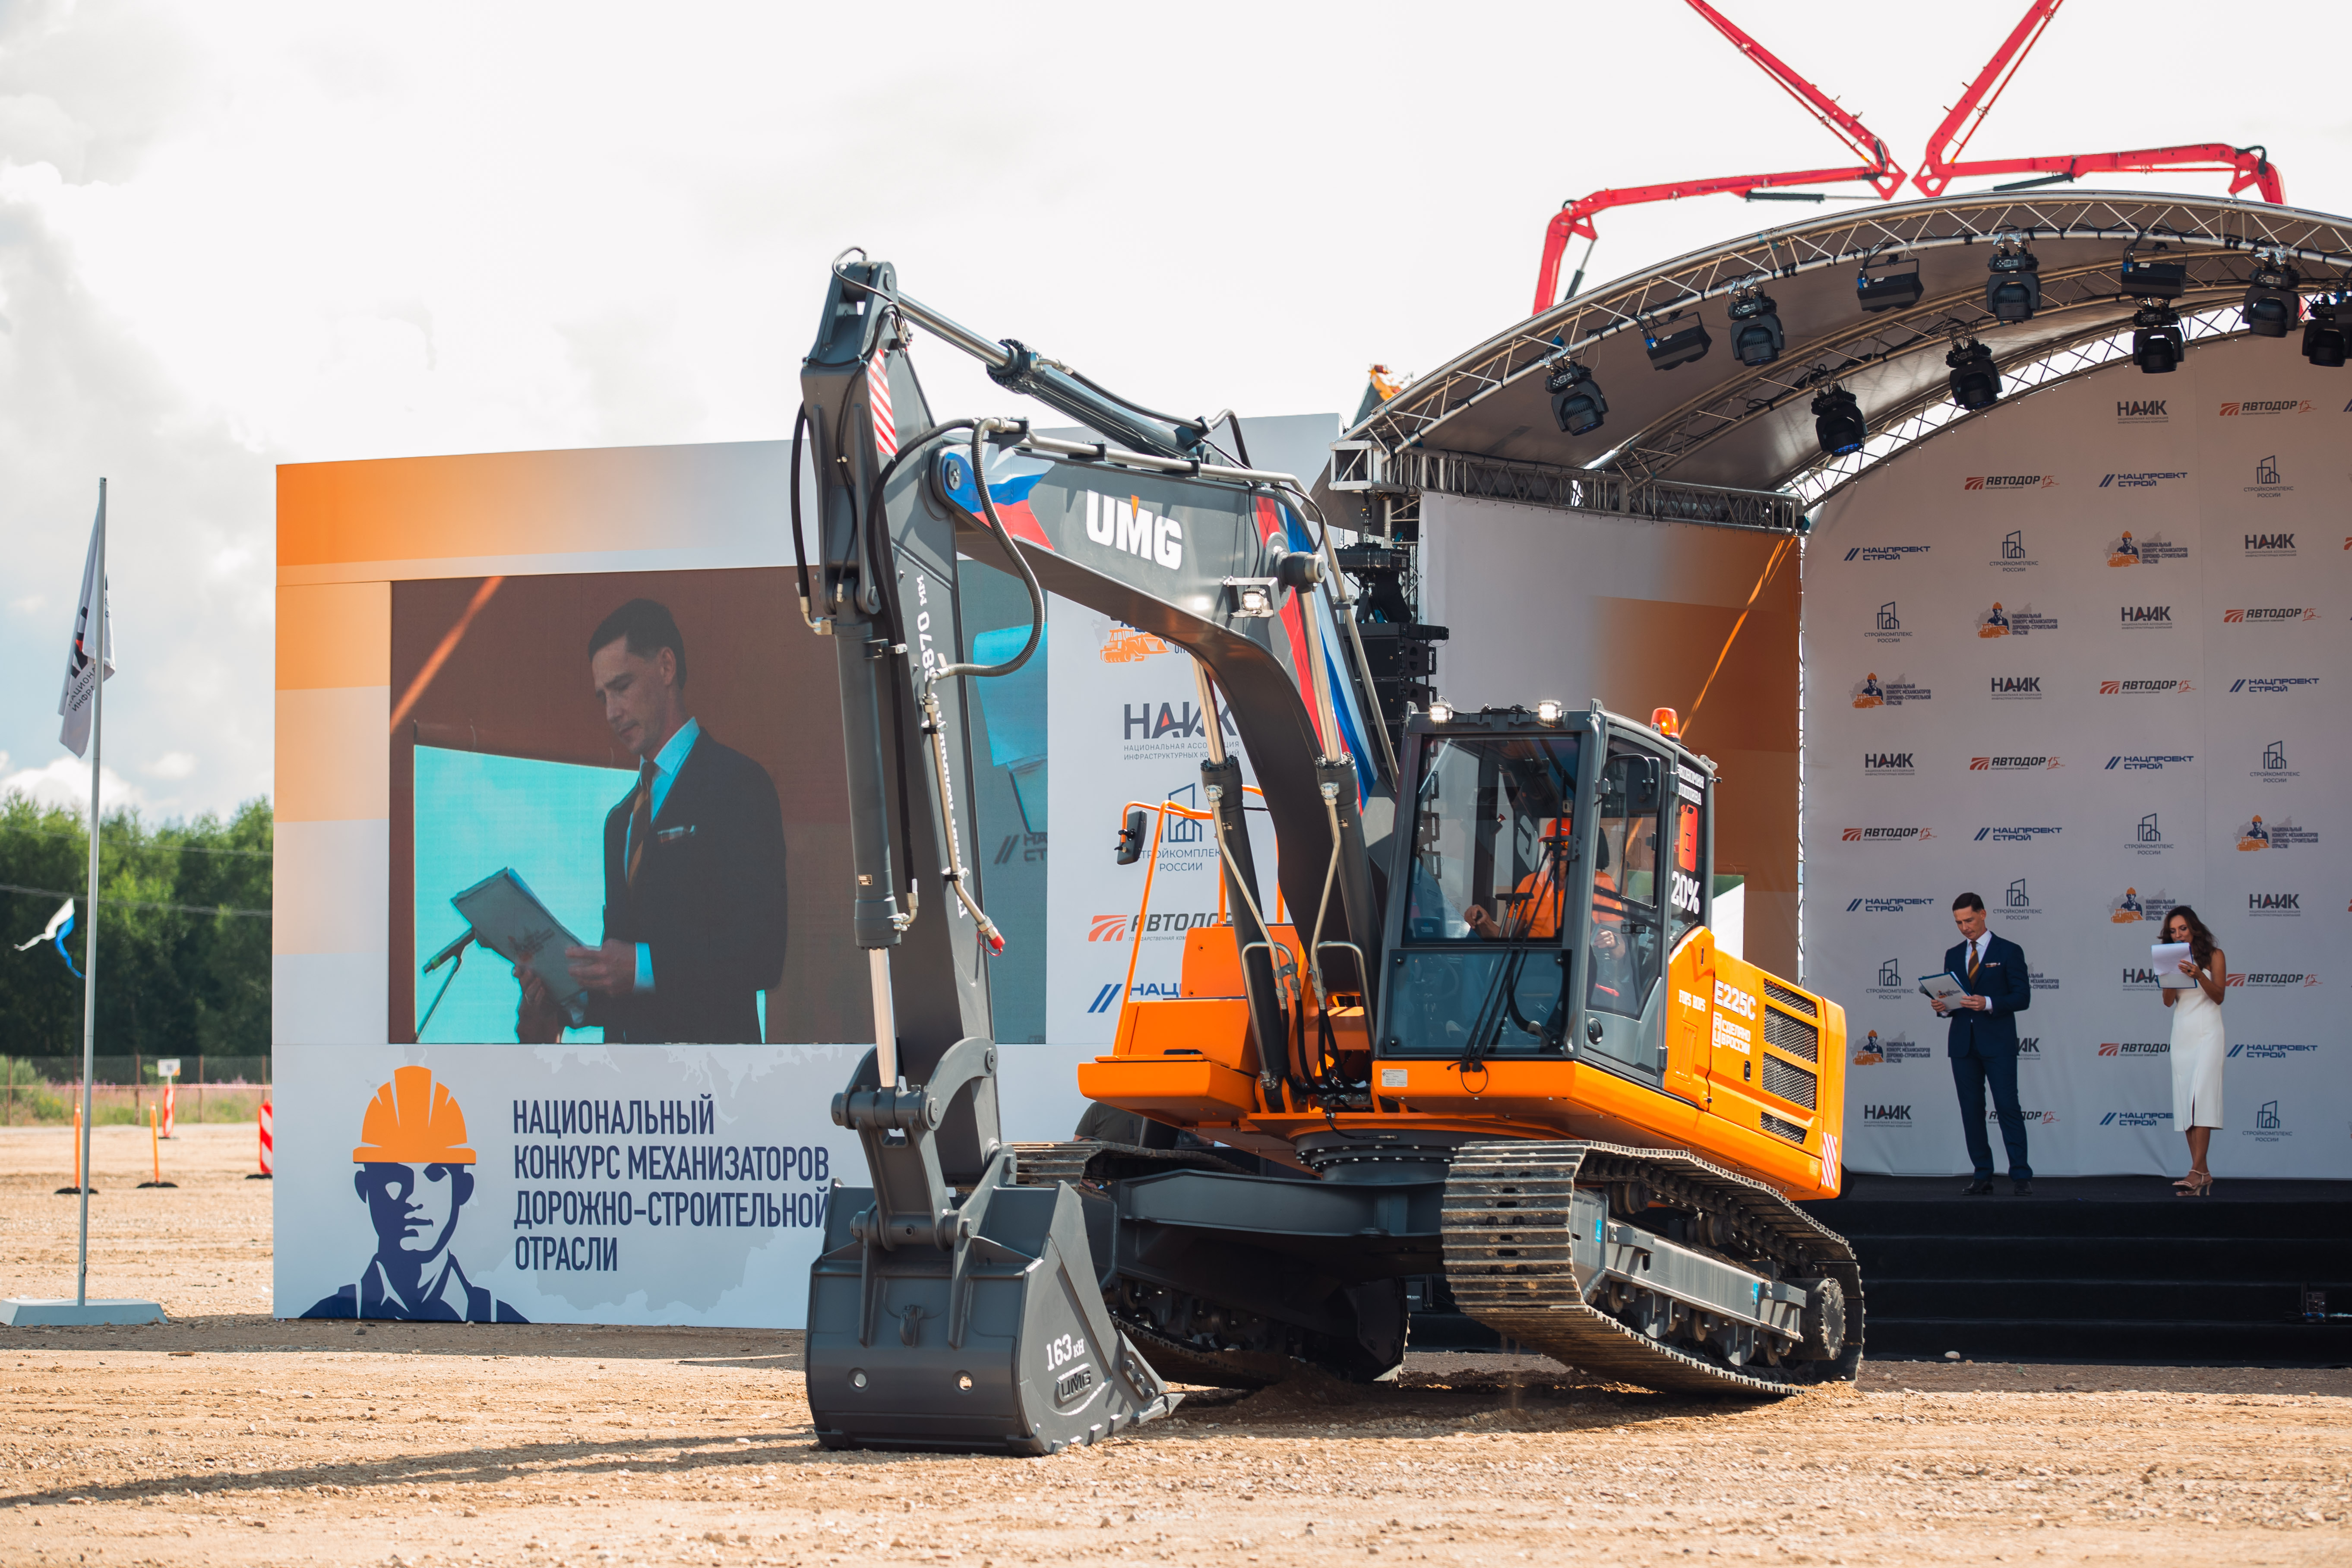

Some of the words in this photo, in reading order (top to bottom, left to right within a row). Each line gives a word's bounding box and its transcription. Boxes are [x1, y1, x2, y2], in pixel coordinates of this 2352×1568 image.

[2117, 400, 2167, 416] НАИК
[2242, 401, 2298, 411] АВТОДОР
[2298, 399, 2312, 413] 15
[1986, 476, 2040, 486] АВТОДОР
[2041, 475, 2055, 488] 15
[2118, 472, 2188, 481] НАЦПРОЕКТ
[1086, 489, 1182, 570] UMG
[2245, 534, 2295, 549] НАИК
[1863, 546, 1931, 554] НАЦПРОЕКТ
[2121, 606, 2172, 621] НАИК
[2246, 608, 2302, 619] АВТОДОР
[2302, 607, 2317, 621] 15
[1991, 677, 2041, 692] НАИК
[2122, 680, 2177, 690] АВТОДОР
[2178, 680, 2192, 693] 15
[1124, 743, 1185, 752] НАЦИОНАЛЬНАЯ
[1124, 752, 1198, 760] ИНФРАСТРУКТУРНЫХ
[1865, 753, 1914, 768] НАИК
[1992, 757, 2046, 767] АВТОДОР
[2046, 756, 2061, 769] 15
[1864, 828, 1918, 838] АВТОДОР
[1919, 827, 1933, 840] 15
[1159, 862, 1203, 872] РОССИИ
[1671, 870, 1700, 914] 20%
[2249, 893, 2300, 909] НАИК
[2248, 974, 2303, 984] АВТОДОР
[2304, 974, 2318, 987] 15
[1714, 979, 1756, 1021] E225C
[1722, 1019, 1751, 1042] СДЕЛАНО
[1726, 1034, 1750, 1055] РОССИИ
[2017, 1037, 2039, 1053] ИК
[513, 1094, 714, 1139] НАЦИОНАЛЬНЫЙ
[1865, 1104, 1912, 1120] НАИК
[2042, 1111, 2056, 1124] 15
[514, 1145, 620, 1179] КОНКУРС
[628, 1146, 829, 1181] МЕХАНИЗАТОРОВ
[514, 1186, 830, 1230] ДОРОЖНО-СТРОИТЕЛЬНОЙ
[515, 1236, 617, 1271] ОТРАСЛИ
[1046, 1334, 1072, 1371] 163
[1061, 1370, 1091, 1398] UMG
